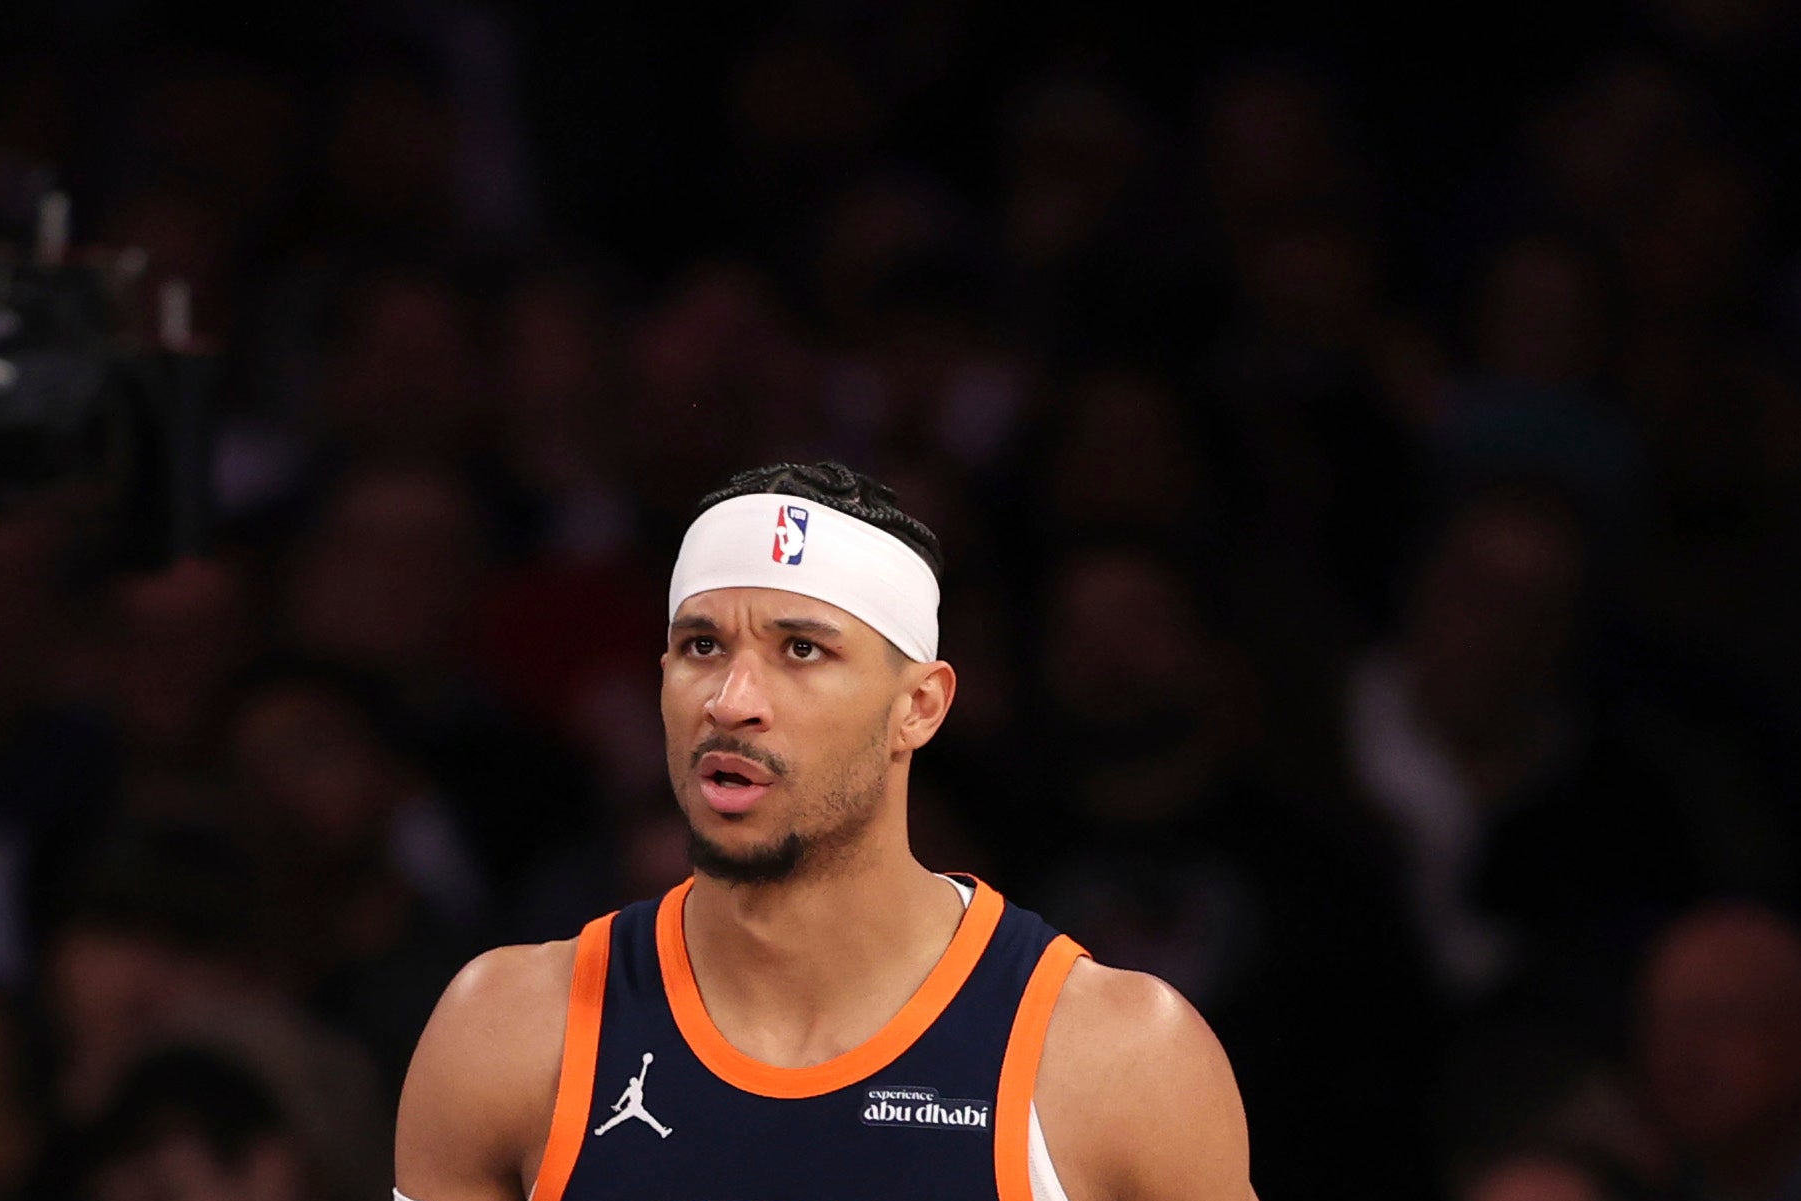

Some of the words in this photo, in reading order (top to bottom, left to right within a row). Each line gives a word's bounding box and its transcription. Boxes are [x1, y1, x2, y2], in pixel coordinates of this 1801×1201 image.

[868, 1089, 934, 1101] experience
[863, 1101, 912, 1122] abu
[915, 1103, 989, 1128] dhabi
